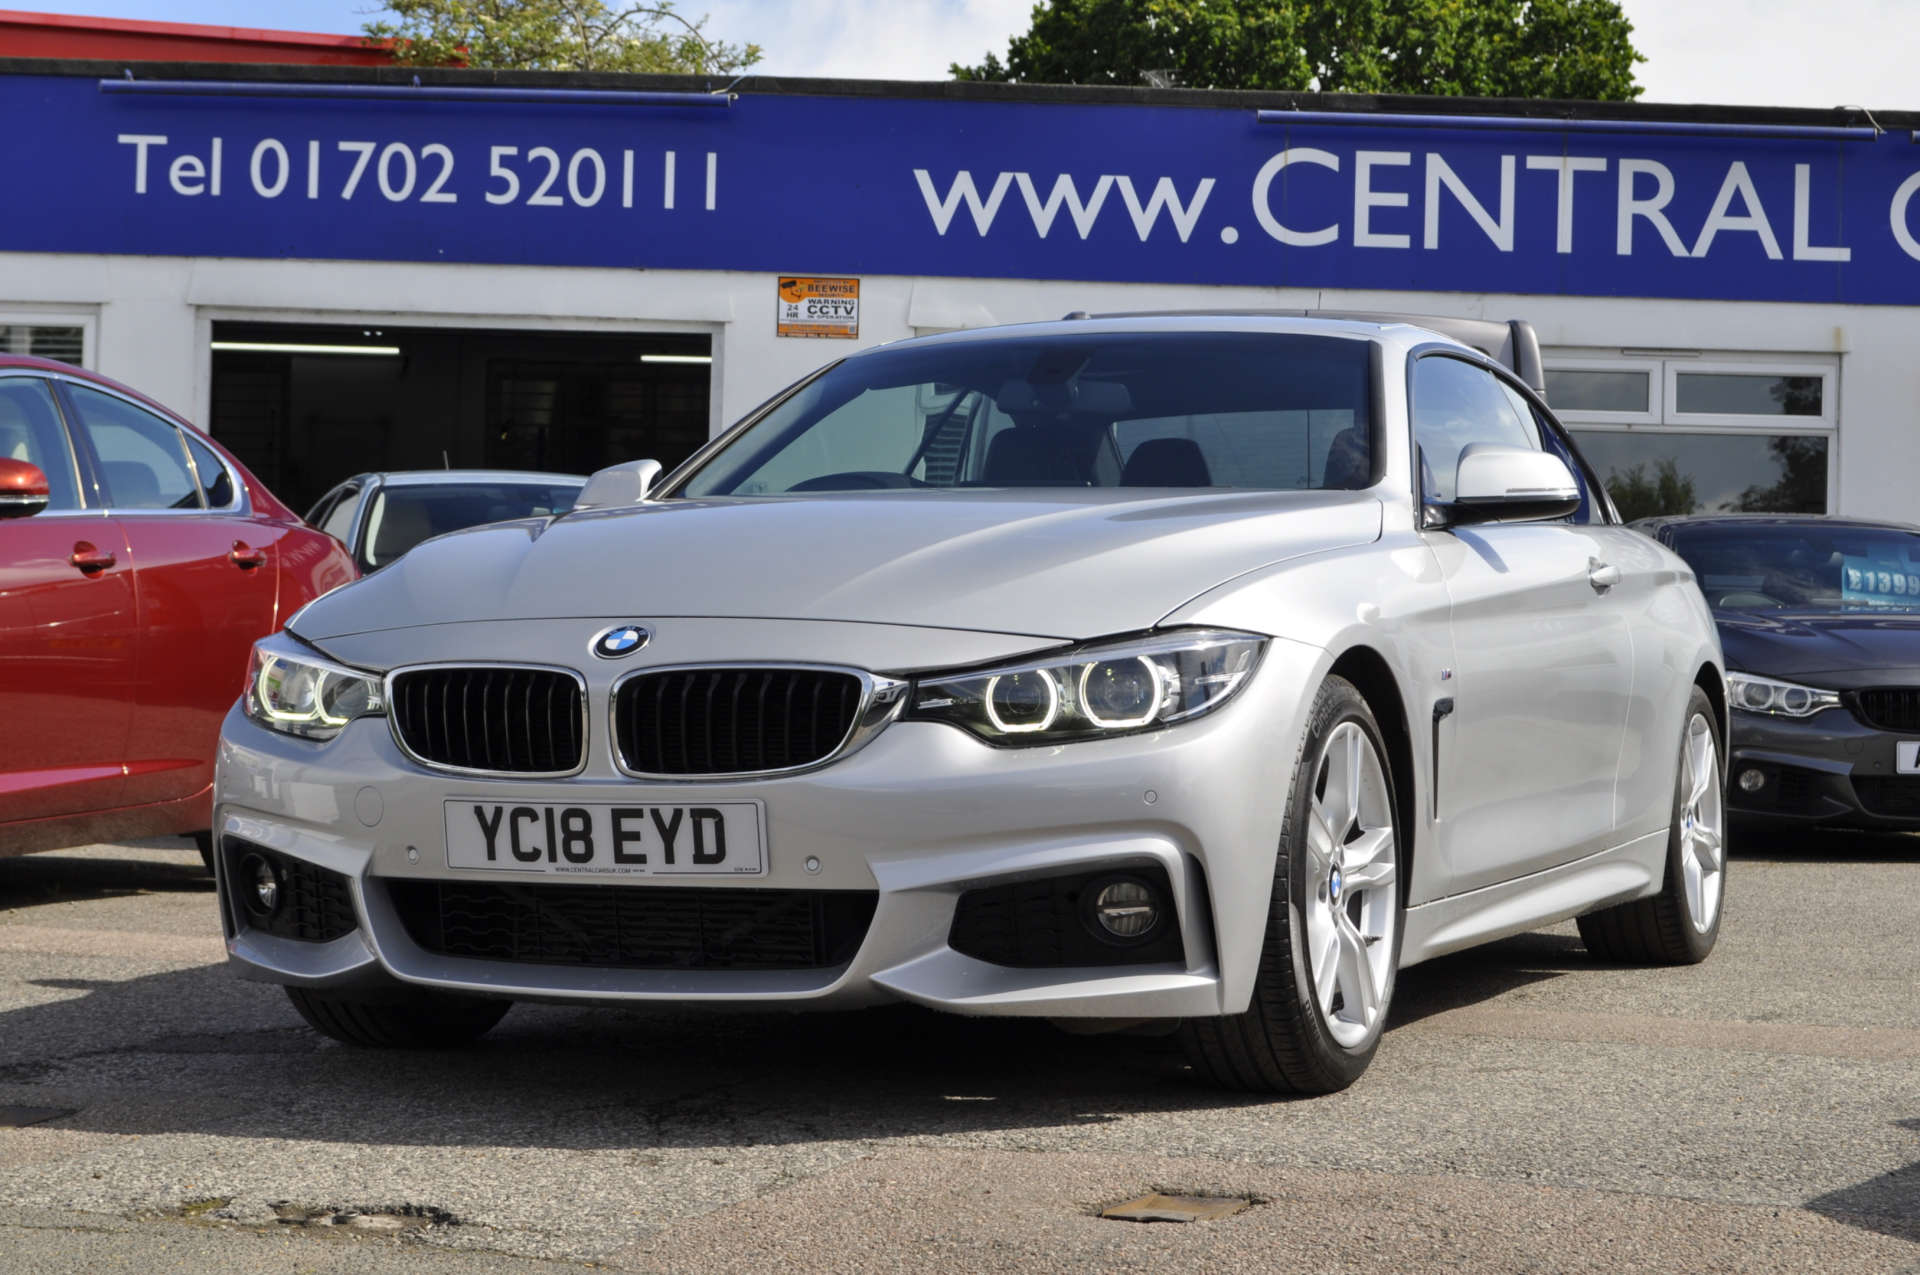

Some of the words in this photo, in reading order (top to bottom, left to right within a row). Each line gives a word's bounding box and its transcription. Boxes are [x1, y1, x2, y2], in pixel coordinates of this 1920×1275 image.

[117, 134, 222, 196] Tel
[250, 138, 458, 203] 01702
[485, 145, 717, 211] 520111
[913, 147, 1851, 262] www.CENTRAL
[807, 284, 855, 293] BEEWISE
[787, 303, 799, 311] 24
[807, 298, 855, 306] WARNING
[807, 304, 854, 315] CCTV
[473, 805, 594, 864] YC18
[610, 807, 727, 865] EYD
